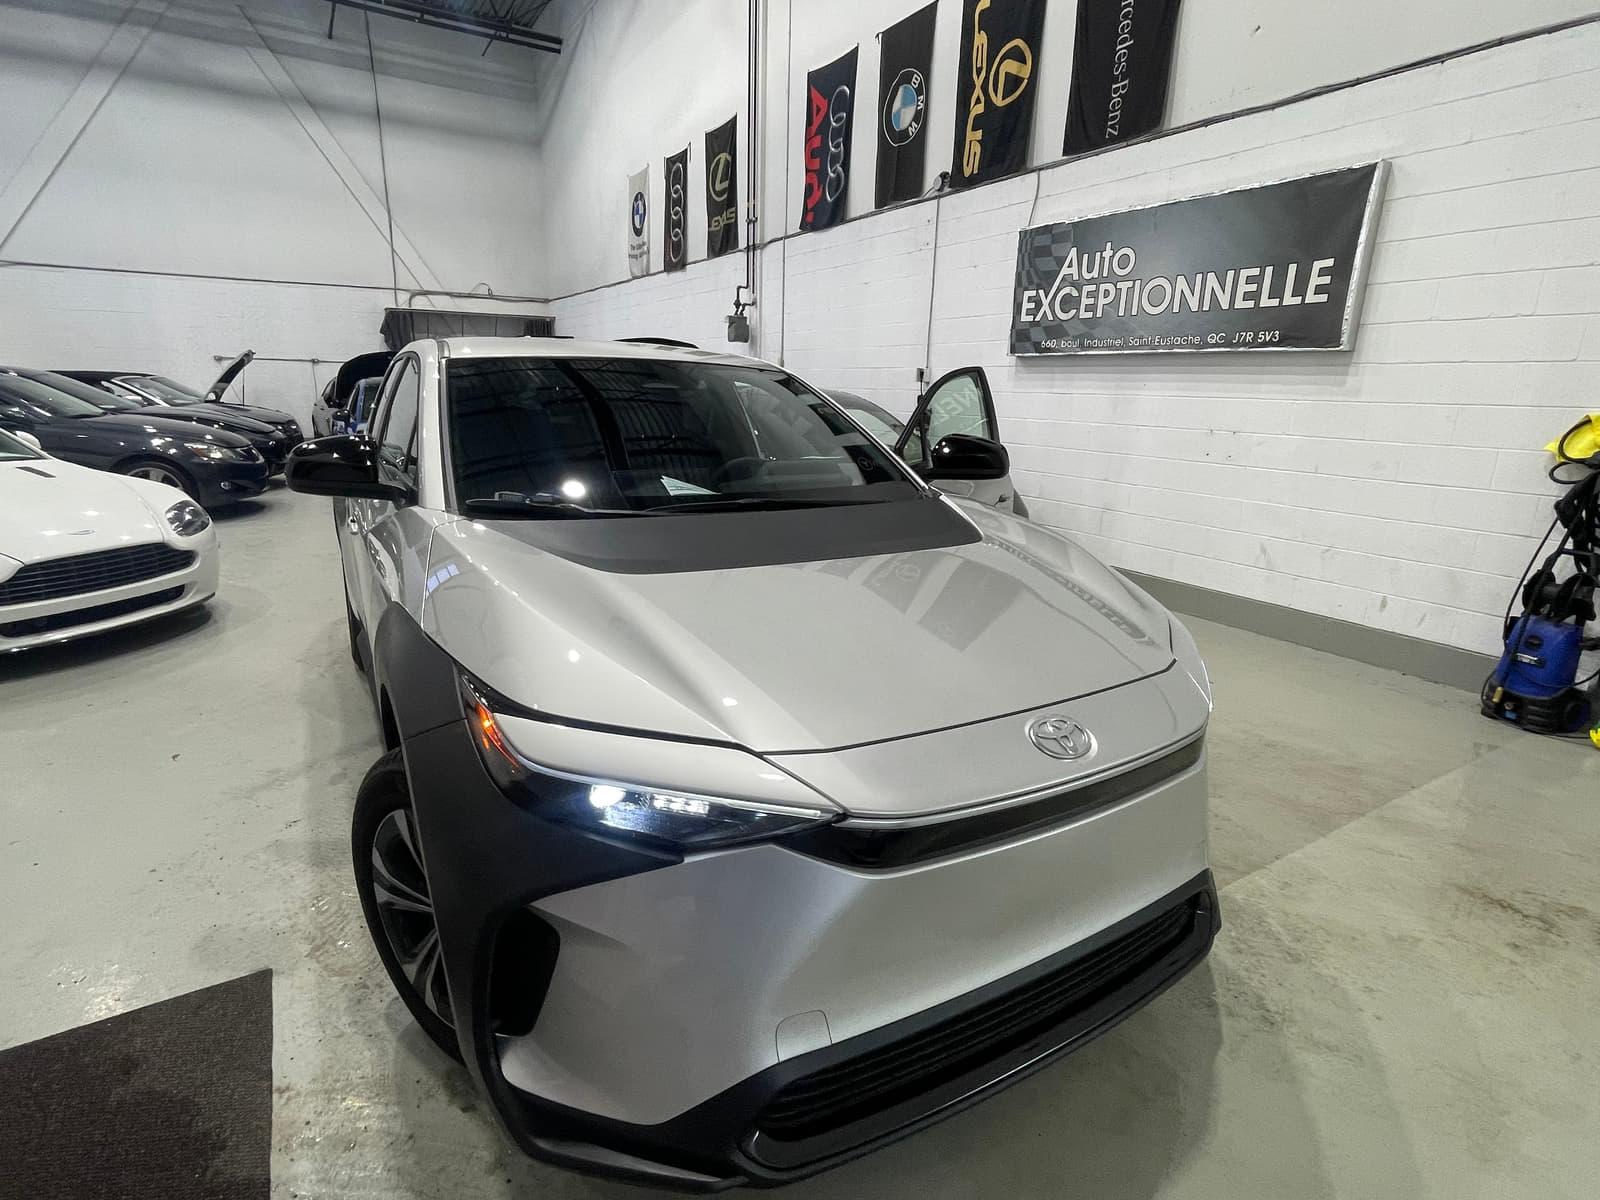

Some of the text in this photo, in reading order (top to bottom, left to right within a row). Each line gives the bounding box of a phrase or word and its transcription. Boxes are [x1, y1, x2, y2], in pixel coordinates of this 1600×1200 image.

[963, 0, 991, 178] LEXUS
[1056, 241, 1137, 281] Auto
[1020, 257, 1335, 322] EXCEPTIONNELLE
[1041, 339, 1058, 348] 660,
[1207, 332, 1226, 344] QC
[1232, 332, 1254, 344] J7R
[1257, 331, 1280, 342] 5V3
